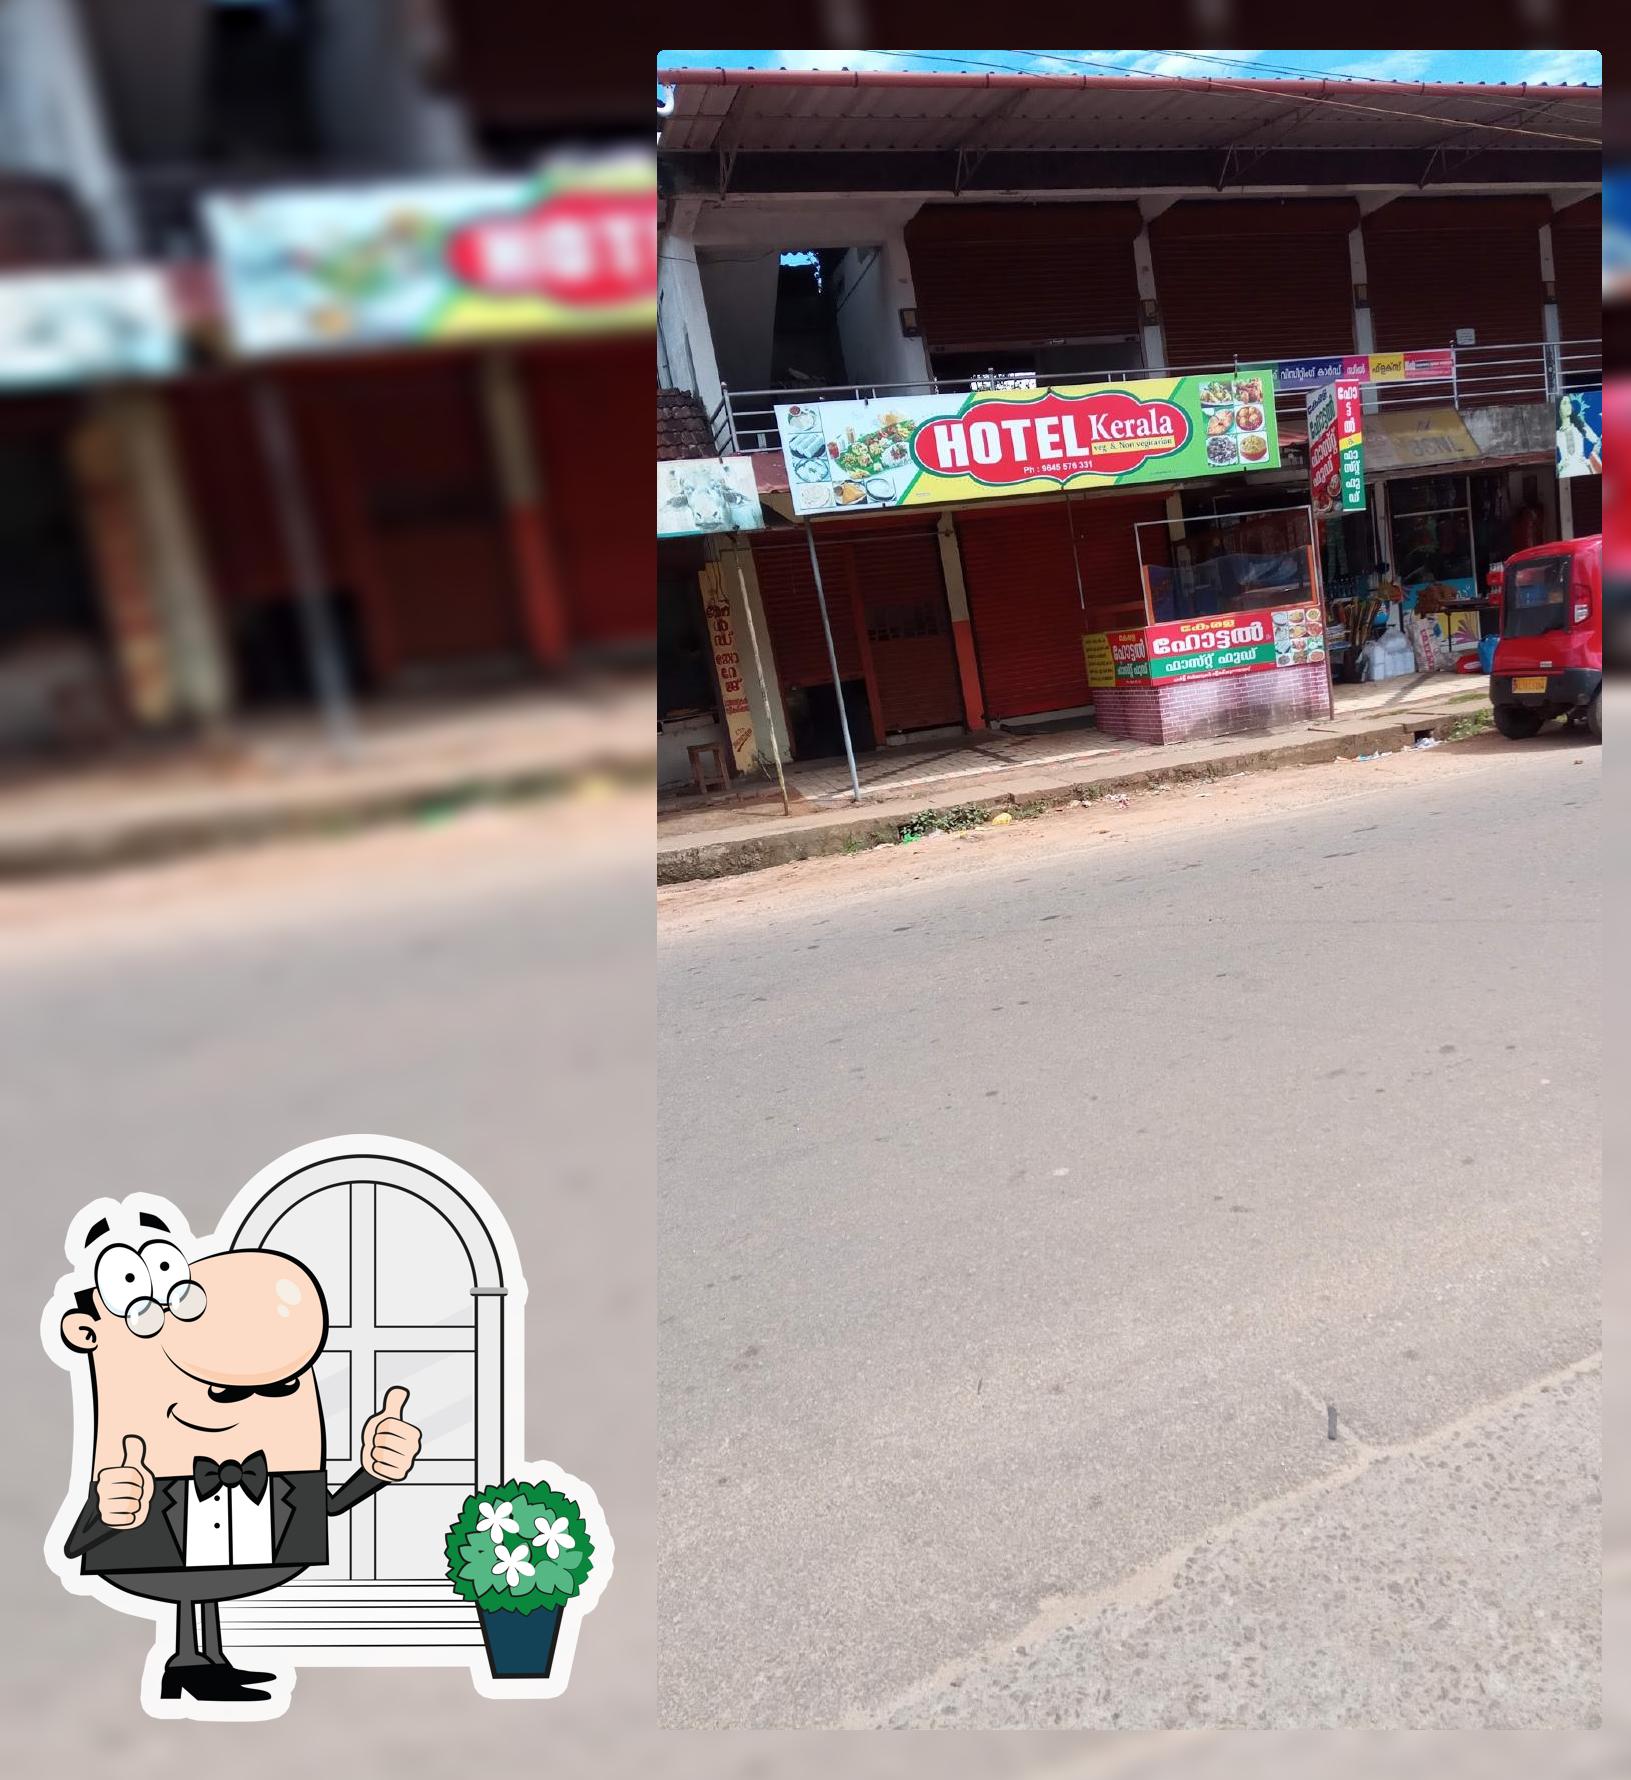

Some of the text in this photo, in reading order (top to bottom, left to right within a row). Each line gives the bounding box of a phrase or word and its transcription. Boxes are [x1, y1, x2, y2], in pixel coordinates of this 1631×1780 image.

[933, 408, 1174, 468] HOTEL Kerala
[1023, 465, 1035, 474] Ph
[1180, 619, 1236, 633] കേരള
[1152, 621, 1264, 655] ഹോട്ടൽ
[1217, 646, 1259, 665] ഫുഡ്
